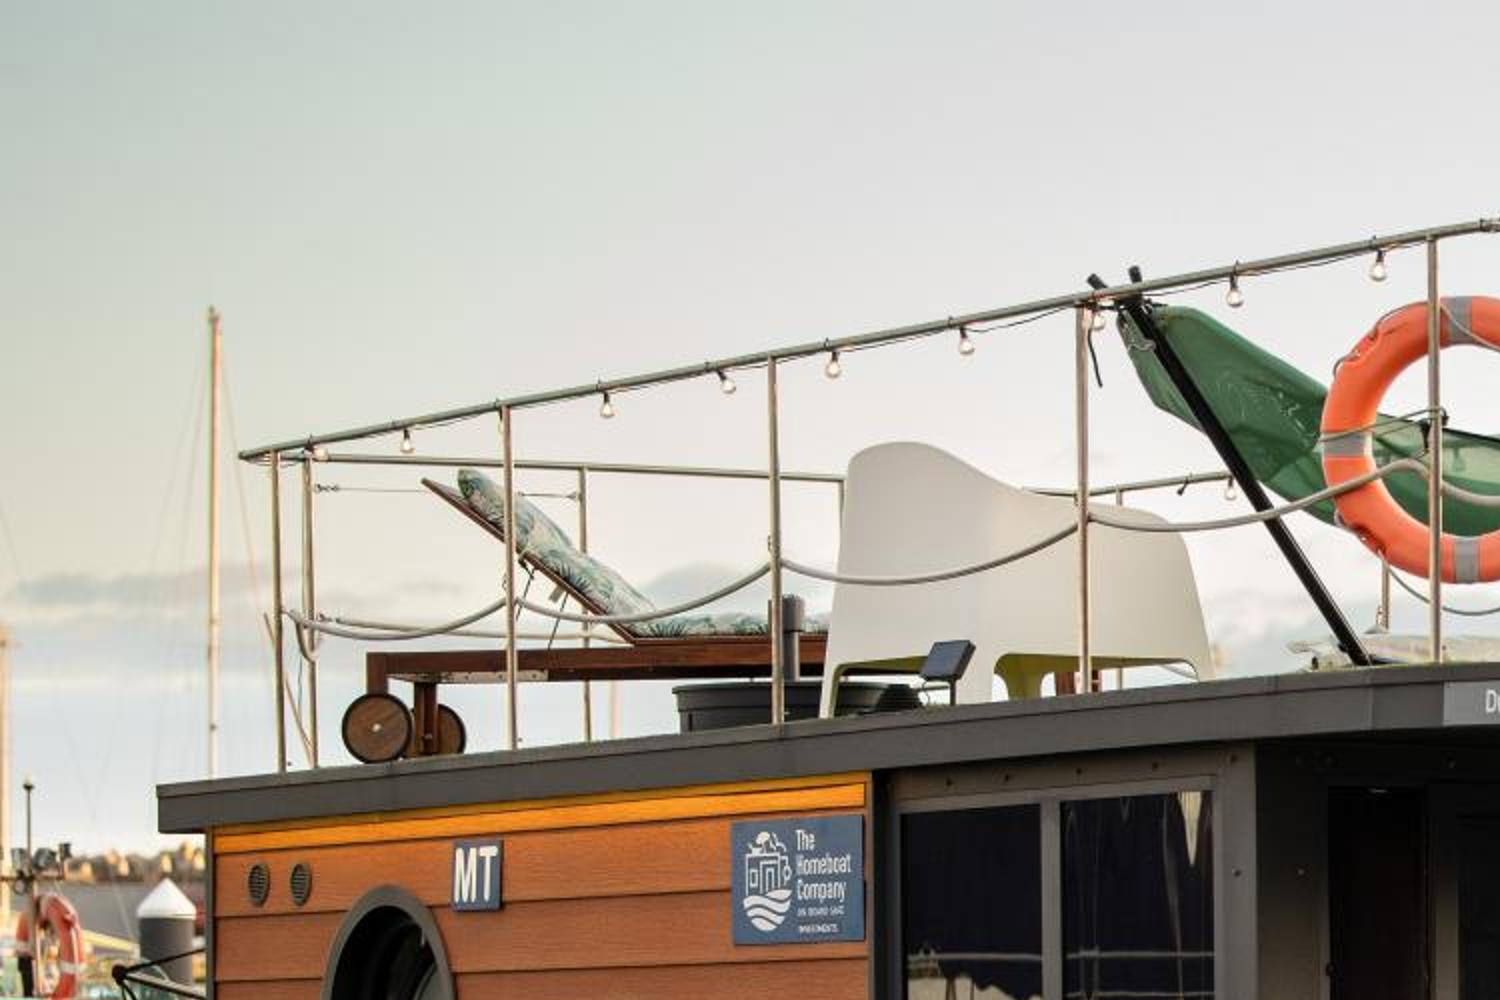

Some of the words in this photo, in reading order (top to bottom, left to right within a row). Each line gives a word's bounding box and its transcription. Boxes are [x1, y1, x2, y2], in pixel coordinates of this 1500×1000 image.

[795, 828, 815, 851] The
[454, 845, 498, 904] MT
[796, 853, 852, 875] Homeboat
[796, 879, 847, 903] Company
